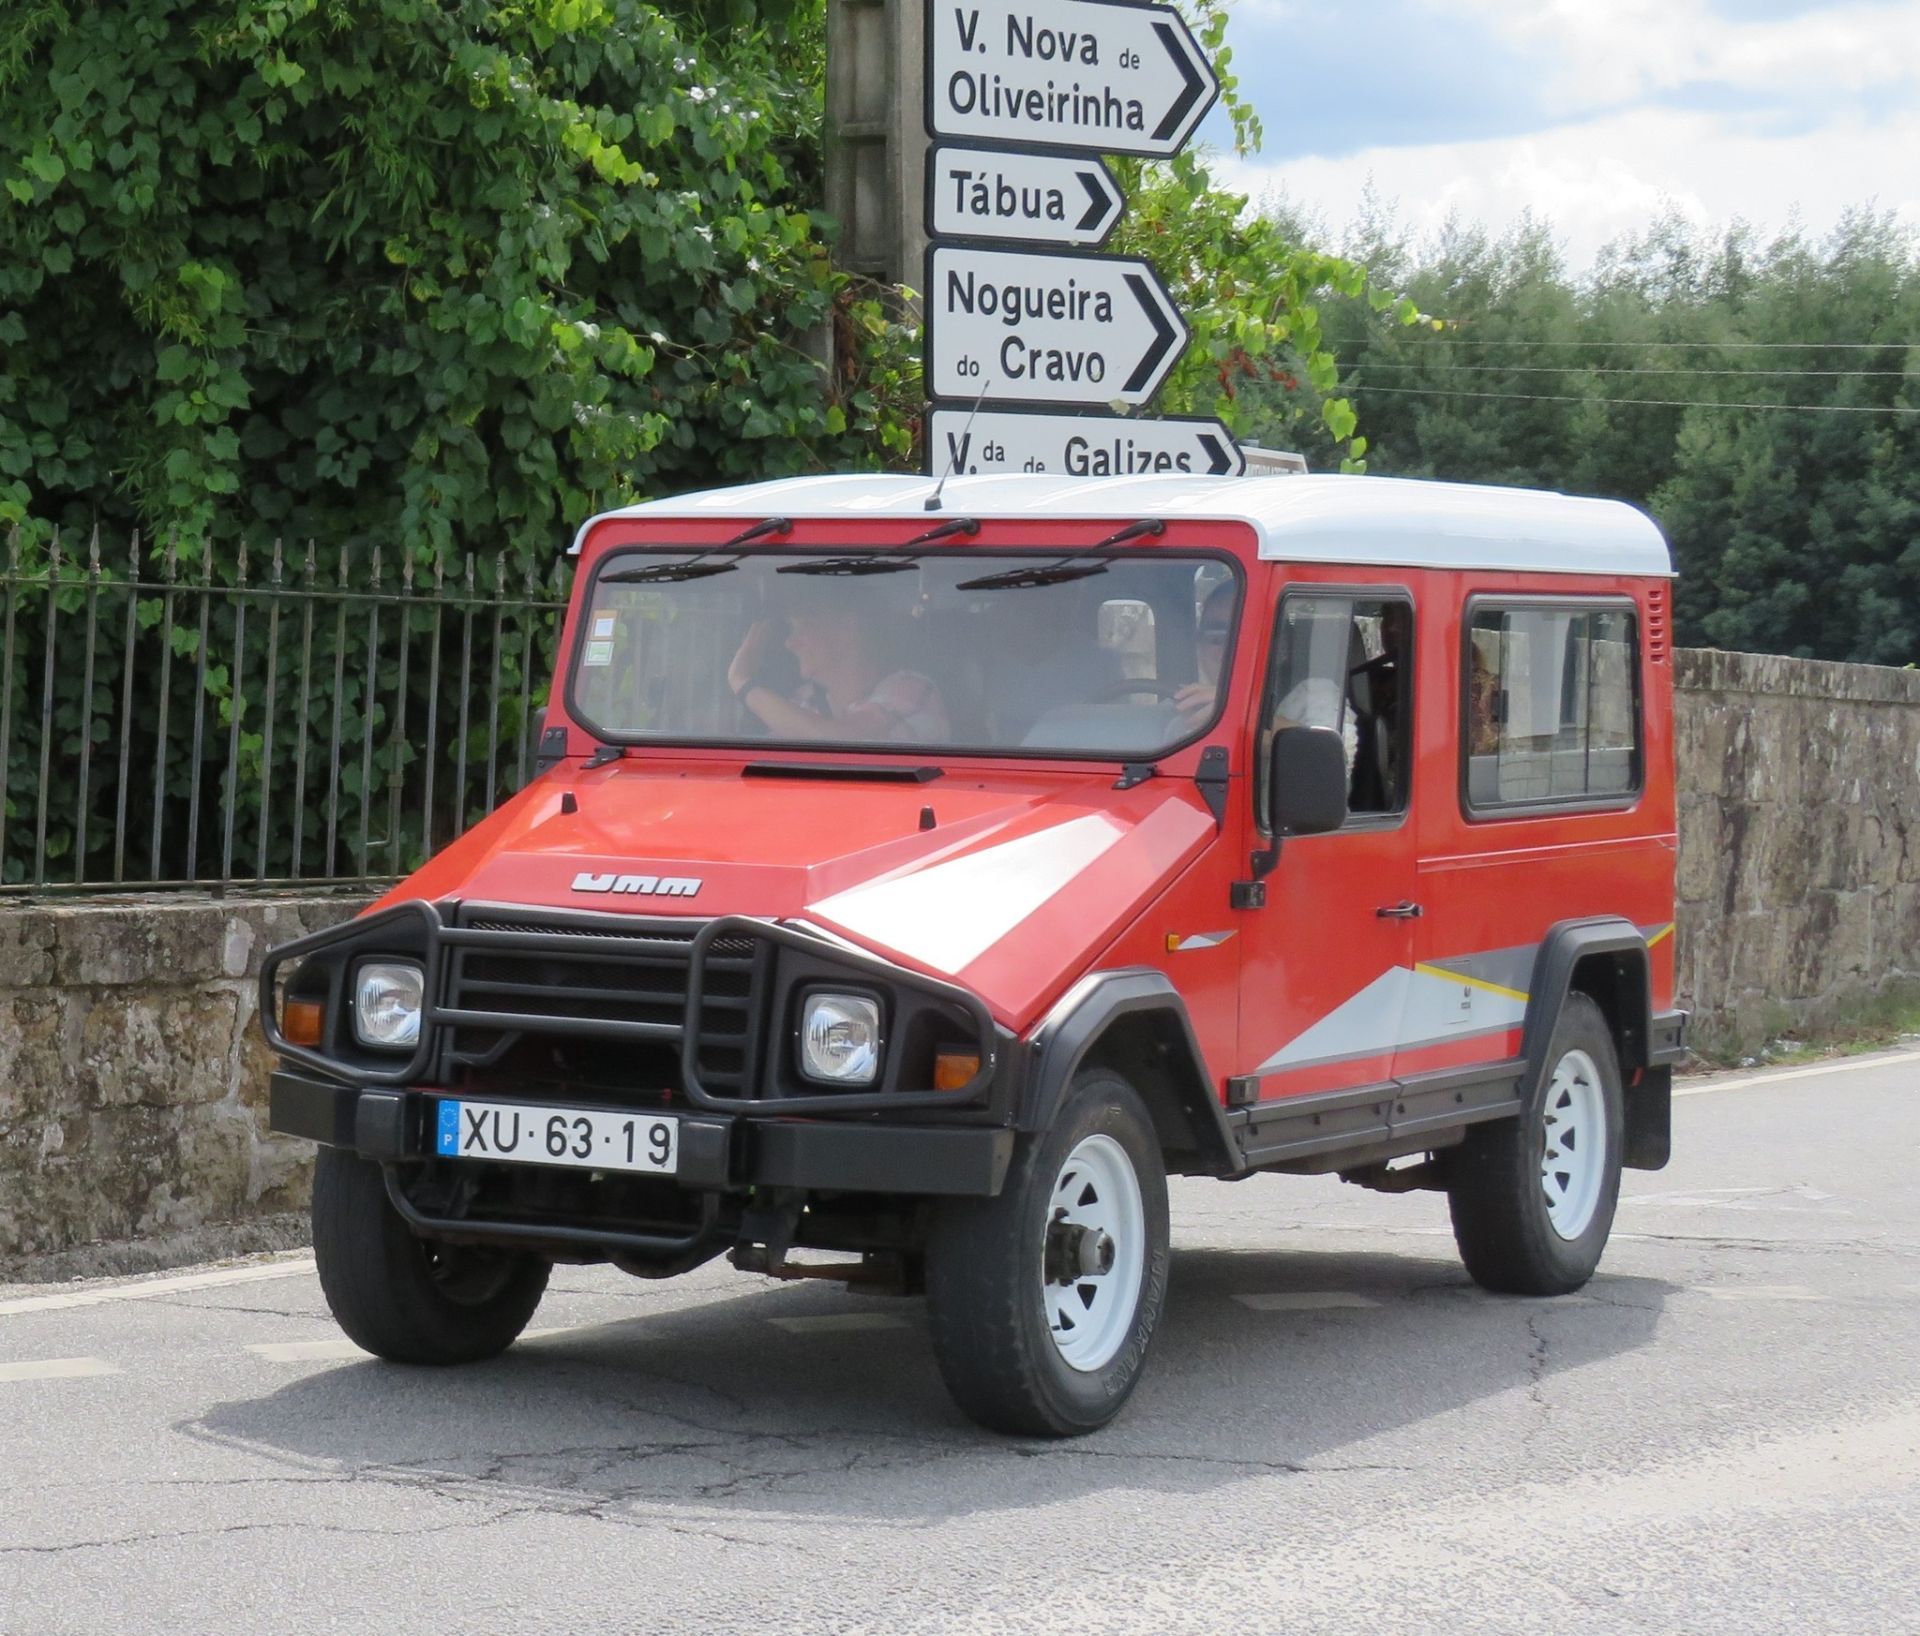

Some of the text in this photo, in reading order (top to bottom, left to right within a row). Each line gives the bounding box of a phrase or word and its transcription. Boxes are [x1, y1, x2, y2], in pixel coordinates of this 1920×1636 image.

[954, 8, 1140, 70] V. Nova de
[948, 70, 1145, 132] Oliveirinha
[949, 169, 1065, 221] Tábua
[948, 270, 1113, 327] Nogueira
[956, 335, 1105, 384] do Cravo
[1023, 456, 1045, 473] de
[1064, 436, 1191, 476] Galizes
[443, 1133, 453, 1146] P
